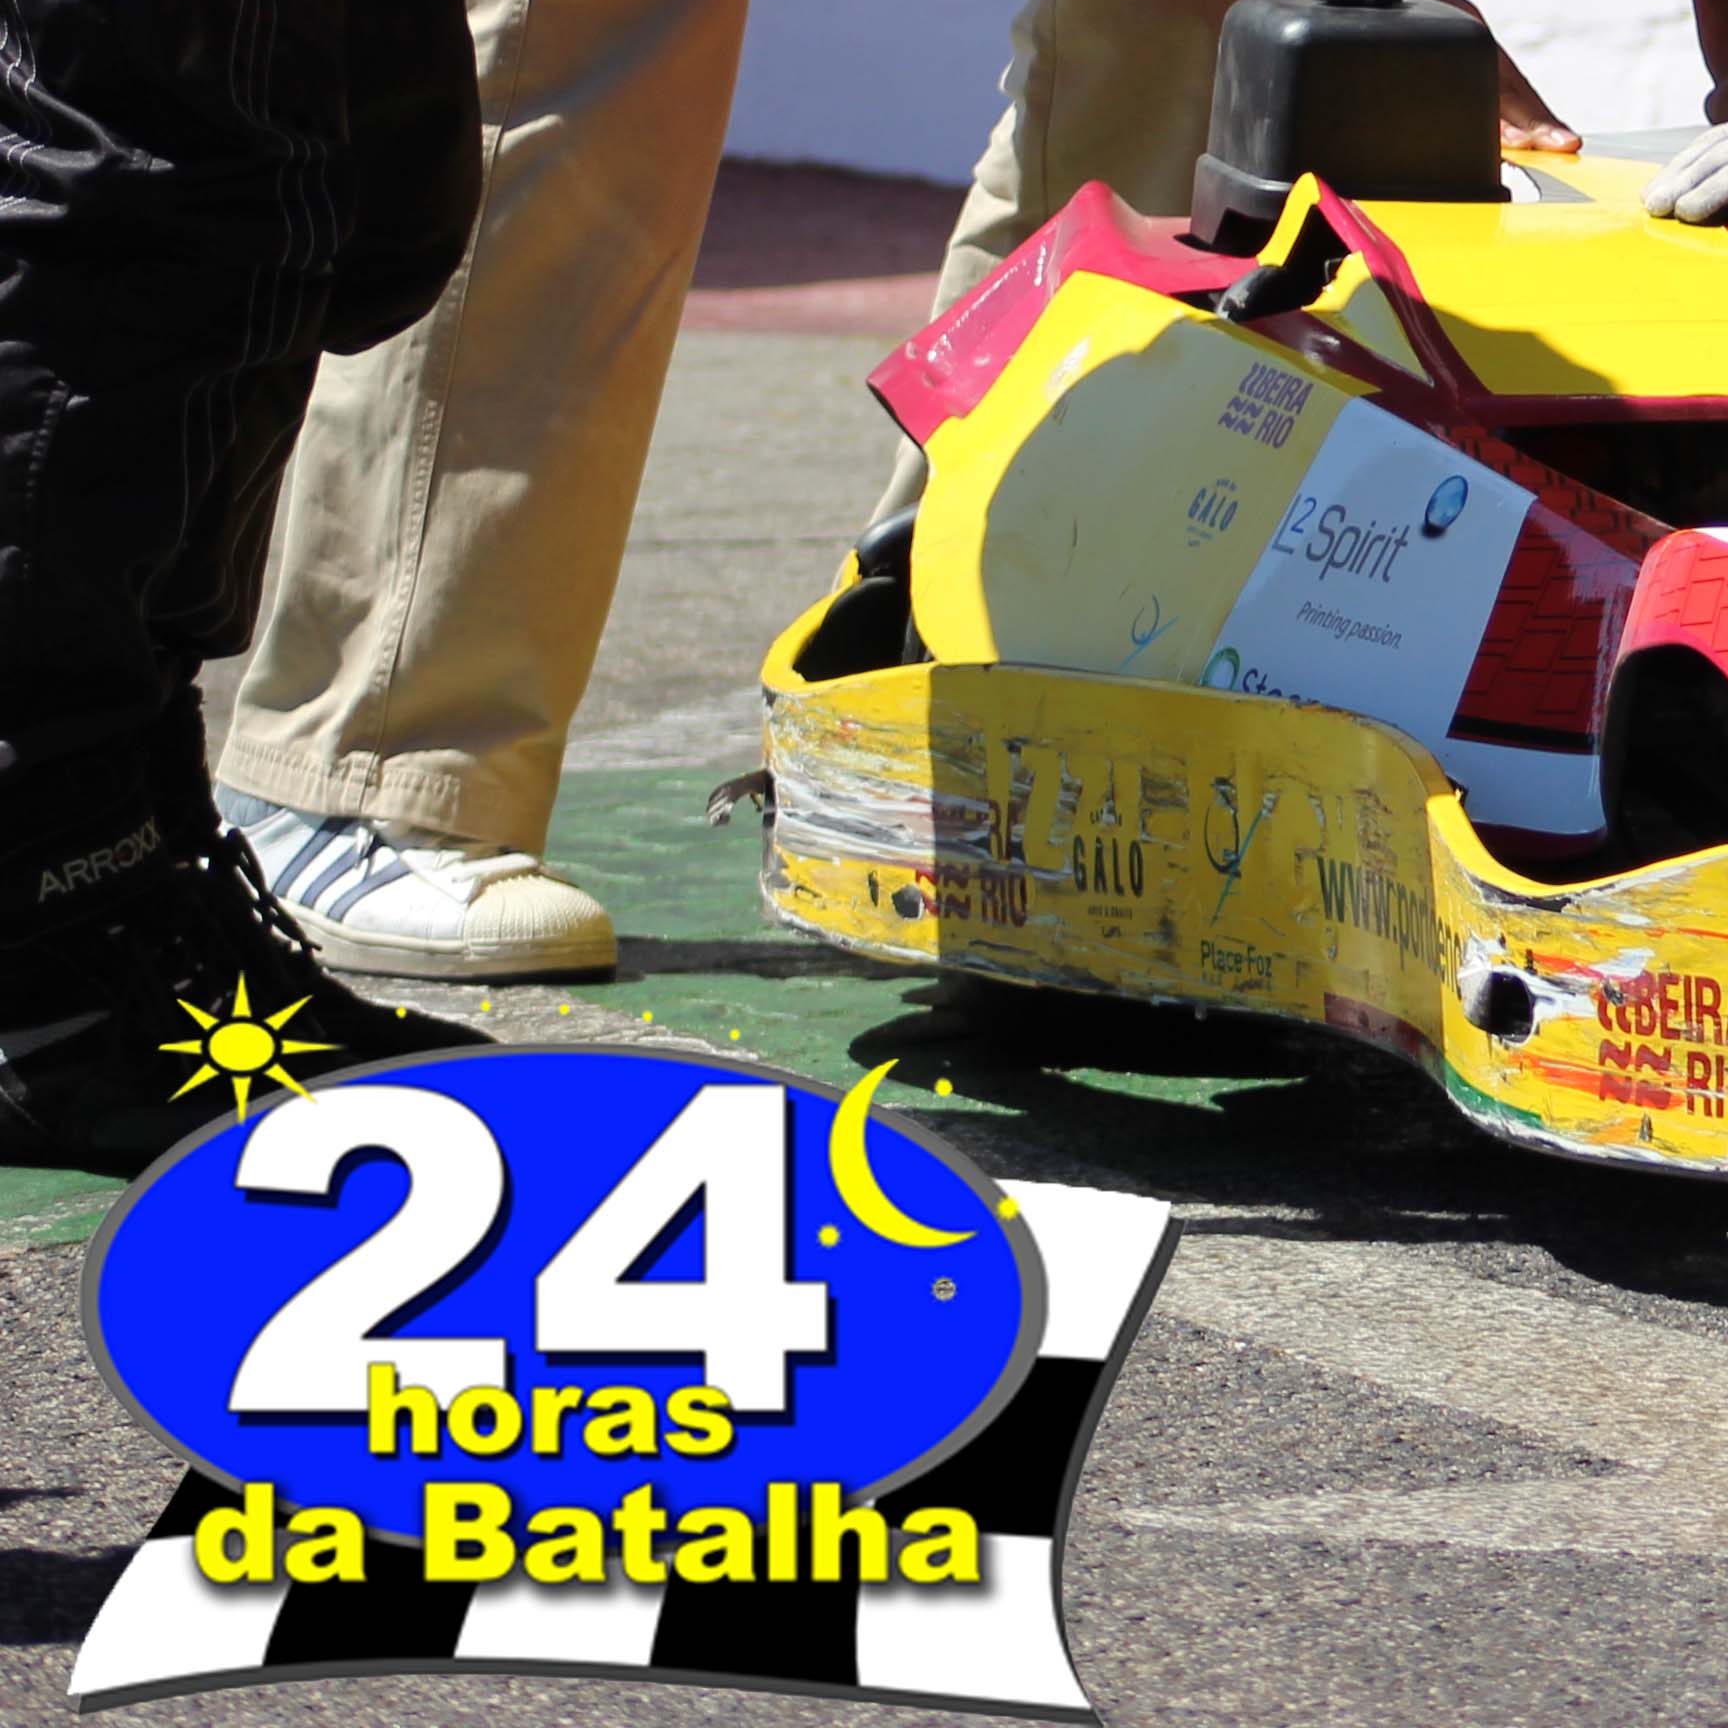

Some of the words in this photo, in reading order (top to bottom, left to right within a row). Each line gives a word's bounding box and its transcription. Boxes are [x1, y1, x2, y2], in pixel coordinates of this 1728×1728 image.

[1254, 409, 1295, 449] RIO
[1305, 504, 1411, 583] Spirit
[1296, 600, 1352, 640] Printing
[37, 814, 162, 902] ARROXX
[980, 863, 1028, 928] RIO
[1200, 939, 1243, 973] Place
[1246, 945, 1272, 978] Foz
